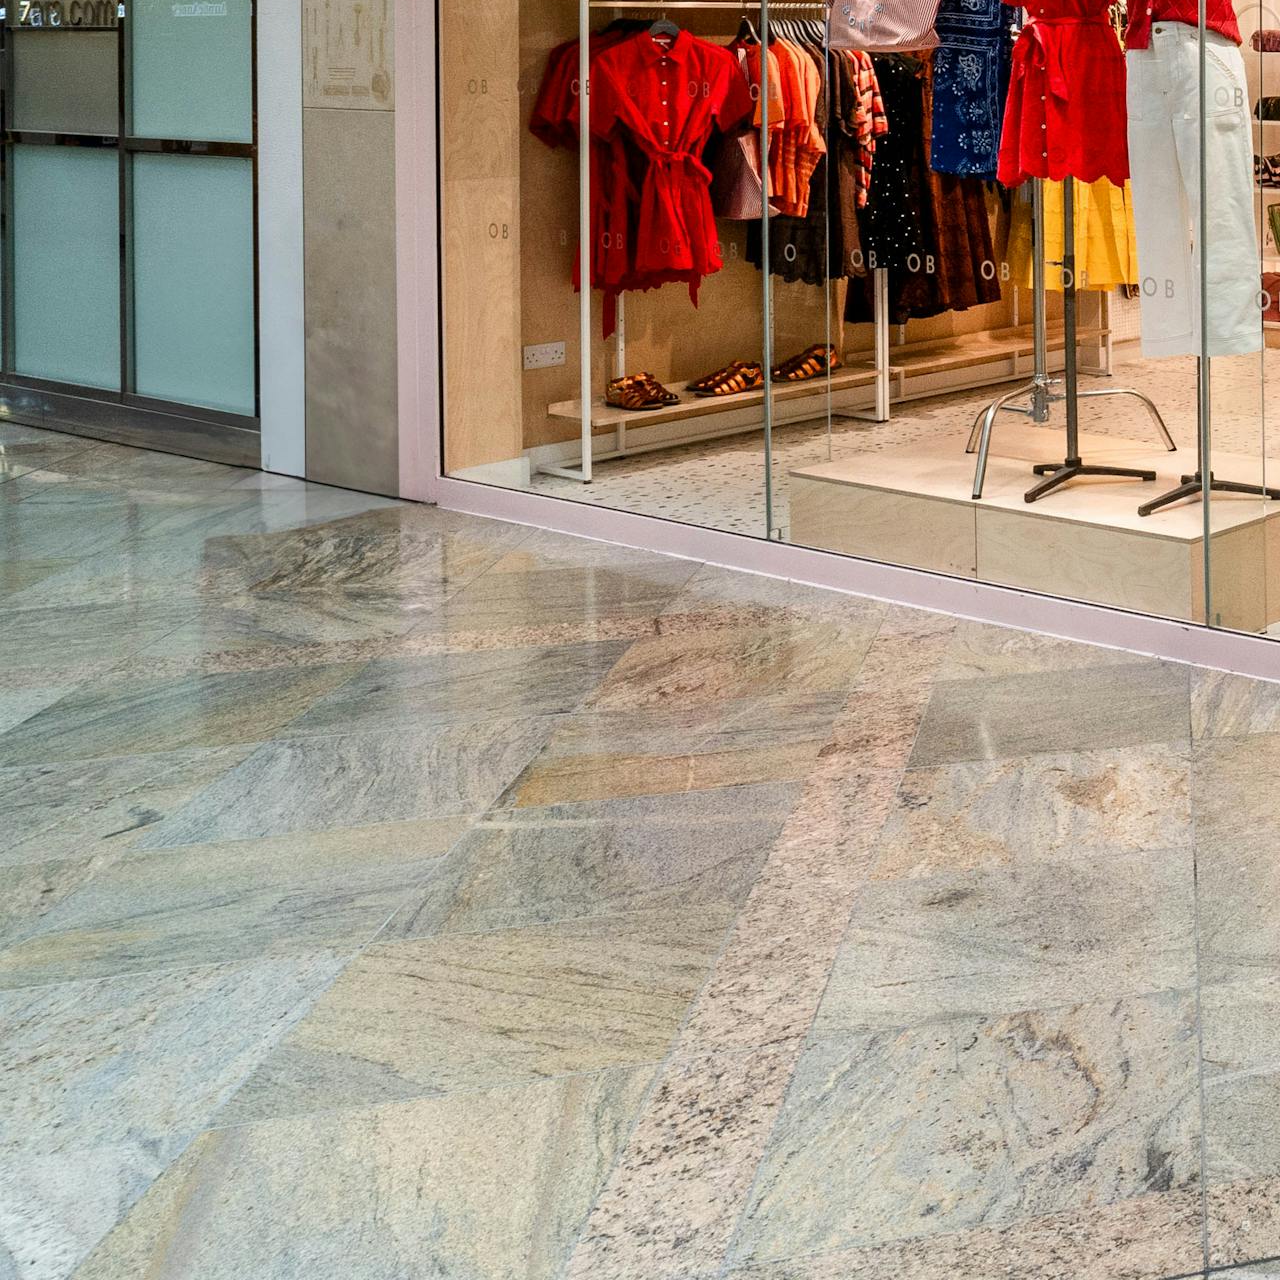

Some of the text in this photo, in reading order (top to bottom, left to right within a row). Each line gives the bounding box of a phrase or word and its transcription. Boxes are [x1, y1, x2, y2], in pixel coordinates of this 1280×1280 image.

[489, 223, 509, 239] OB
[850, 249, 878, 269] OB
[907, 253, 935, 274] OB
[980, 260, 1010, 281] OB
[1142, 276, 1175, 299] OB
